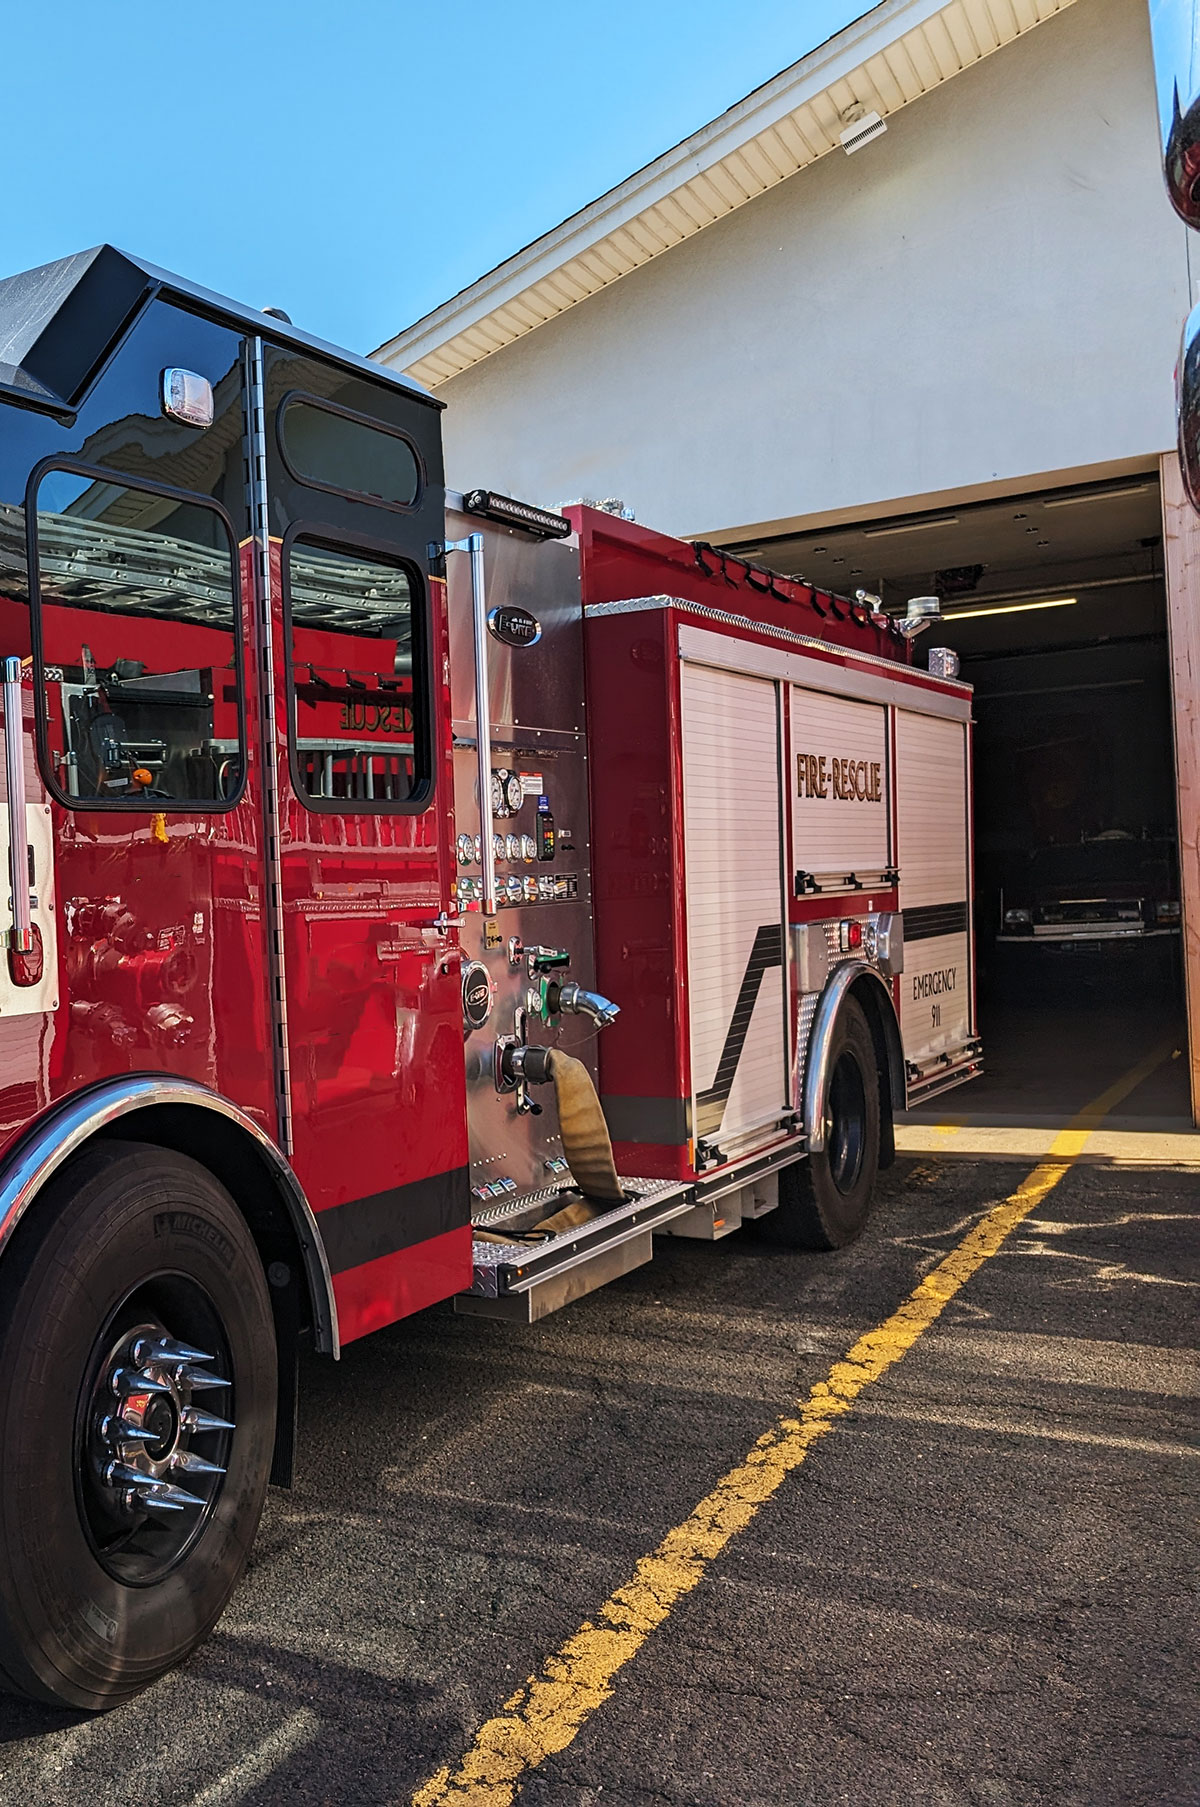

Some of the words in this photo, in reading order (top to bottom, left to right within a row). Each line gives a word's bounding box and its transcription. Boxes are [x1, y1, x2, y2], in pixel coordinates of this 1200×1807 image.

[797, 753, 882, 802] FIRE-RESCUE
[913, 967, 957, 1000] EMERGENCY
[931, 1004, 941, 1028] 911
[173, 1213, 235, 1262] MICHELIN
